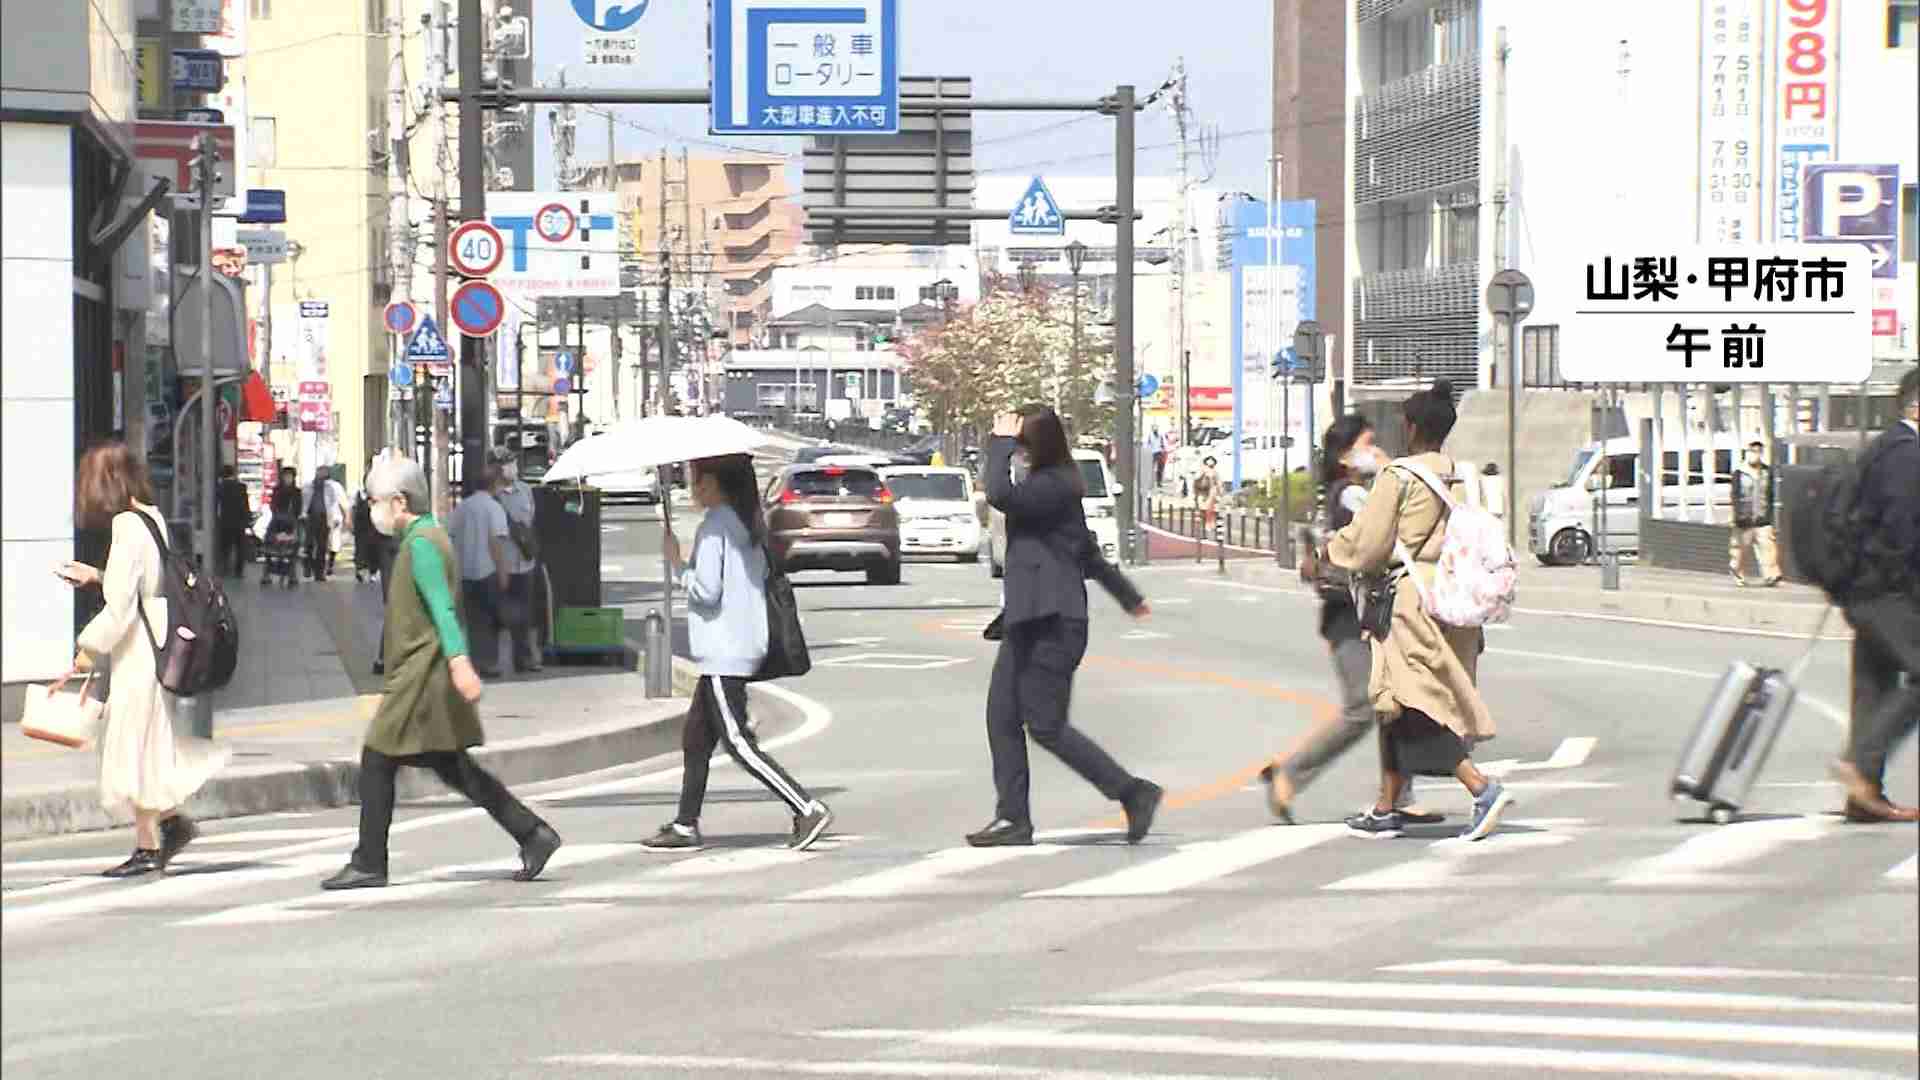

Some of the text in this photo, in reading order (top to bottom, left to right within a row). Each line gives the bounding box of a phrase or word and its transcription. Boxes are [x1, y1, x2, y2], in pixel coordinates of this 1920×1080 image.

[773, 33, 873, 57] 一般車
[775, 63, 875, 86] ロータリー
[761, 104, 888, 127] 大型車進入不可
[1822, 171, 1882, 237] P
[462, 238, 491, 262] 40
